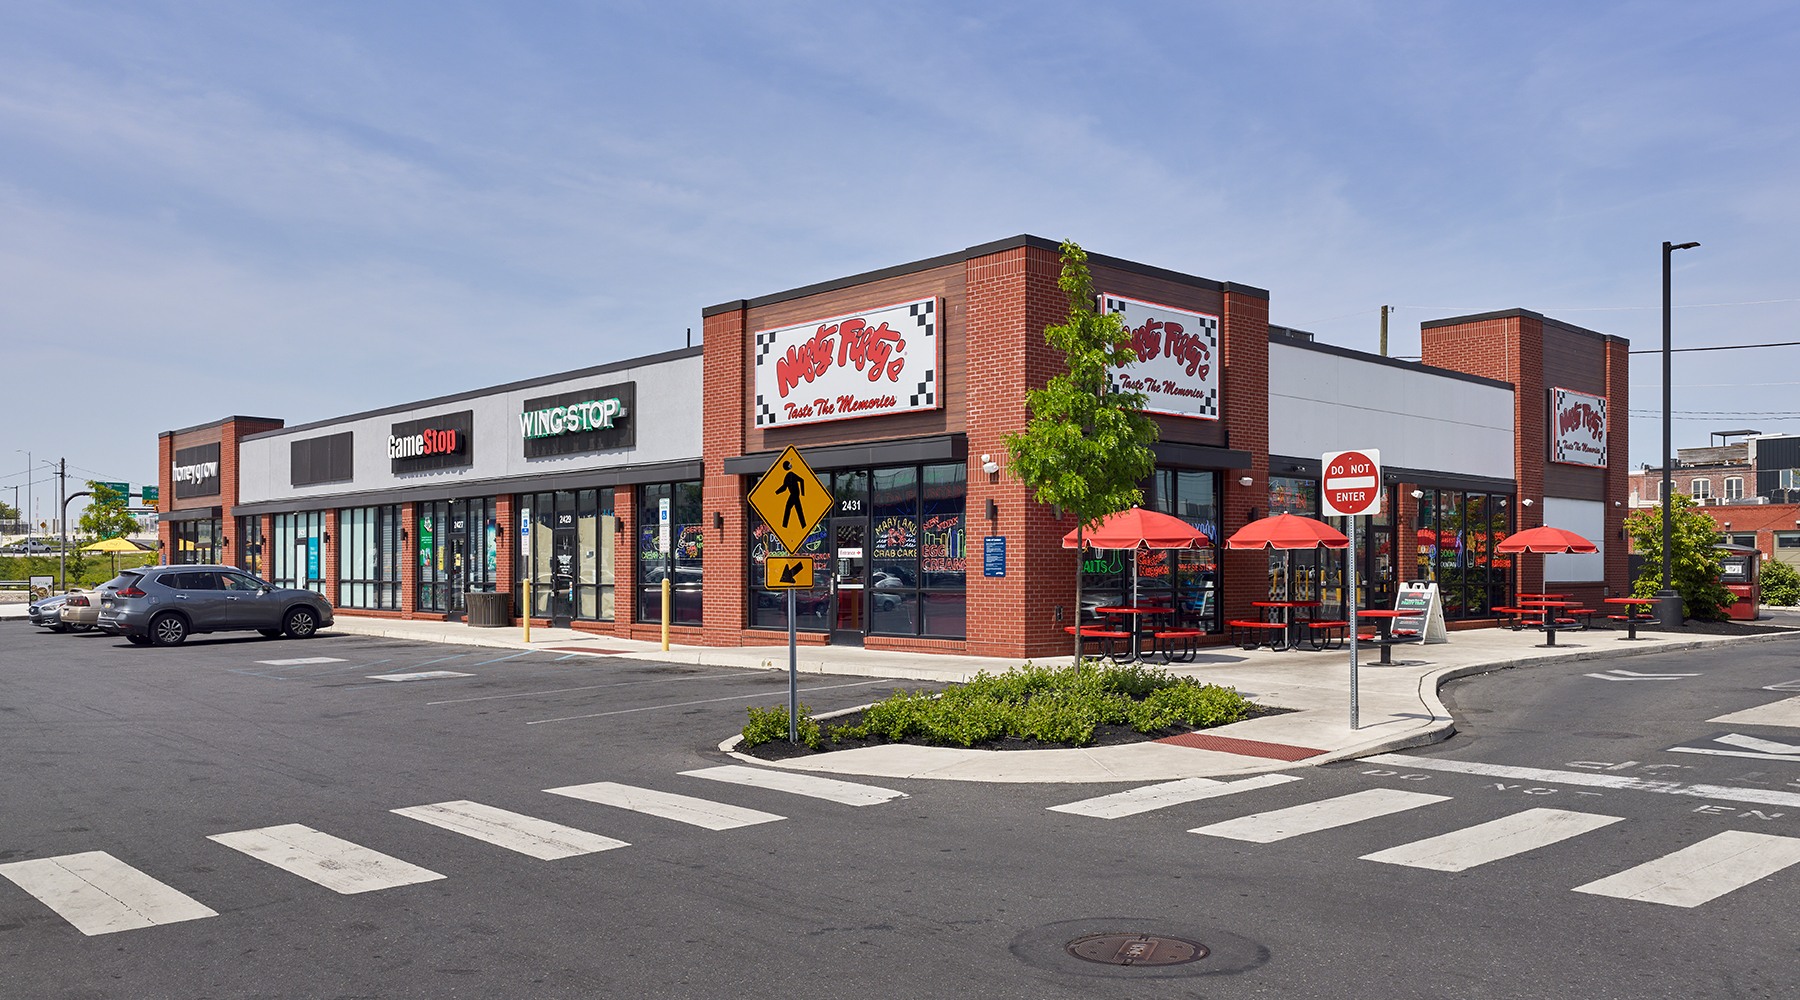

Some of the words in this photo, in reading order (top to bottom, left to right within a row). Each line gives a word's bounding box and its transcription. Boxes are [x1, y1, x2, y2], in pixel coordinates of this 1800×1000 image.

[1119, 374, 1144, 391] Taste
[1144, 377, 1161, 393] The
[1162, 380, 1204, 399] Memories
[784, 403, 813, 420] Taste
[814, 398, 835, 416] The
[837, 395, 897, 413] Memories
[388, 428, 456, 459] GameStop
[172, 461, 218, 485] honeygrow
[1331, 465, 1344, 475] DO
[1350, 464, 1371, 474] NOT
[1336, 492, 1366, 502] ENTER
[842, 500, 861, 511] 2431
[559, 515, 572, 524] 2429
[873, 549, 896, 557] CRAB
[922, 544, 947, 557] EGG
[1082, 560, 1108, 573] ALTS
[1361, 769, 1432, 781] DO
